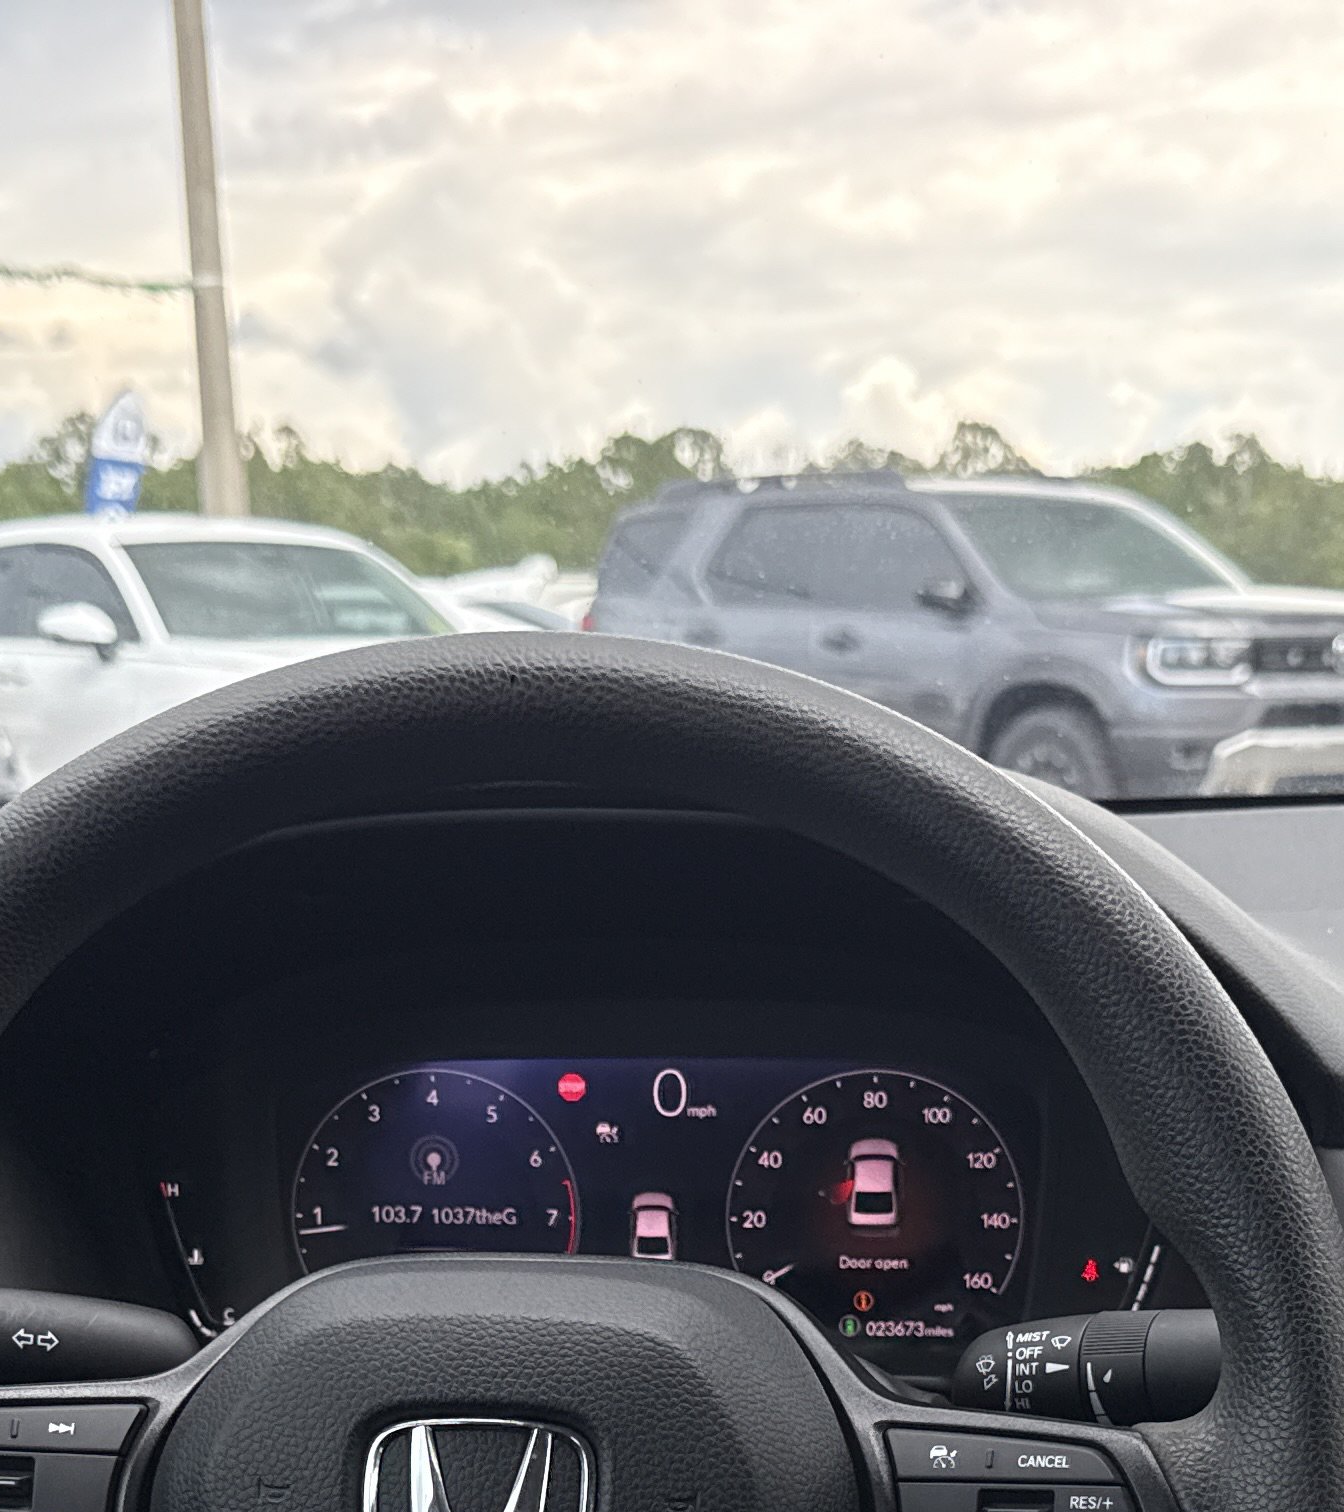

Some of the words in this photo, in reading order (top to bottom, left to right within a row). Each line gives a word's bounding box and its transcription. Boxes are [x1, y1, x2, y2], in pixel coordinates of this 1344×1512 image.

[426, 1089, 439, 1106] 4
[652, 1068, 687, 1117] 0
[687, 1103, 716, 1121] mph
[862, 1092, 888, 1109] 80
[367, 1105, 381, 1122] 3
[486, 1105, 498, 1123] 5
[802, 1107, 827, 1125] 60
[921, 1107, 951, 1124] 100
[326, 1148, 339, 1167] 2
[529, 1150, 542, 1168] 6
[757, 1151, 782, 1169] 40
[966, 1151, 996, 1169] 120
[422, 1171, 446, 1186] FM
[167, 1184, 179, 1197] H
[313, 1207, 323, 1225] 1
[371, 1206, 422, 1224] 103.7
[431, 1207, 517, 1226] 1037theG
[546, 1209, 559, 1227] 7
[742, 1211, 766, 1229] 20
[981, 1213, 1010, 1230] 140
[839, 1254, 872, 1270] Door
[873, 1258, 909, 1271] open
[963, 1273, 993, 1290] 160
[866, 1320, 925, 1337] 023673
[925, 1326, 954, 1337] miles
[1016, 1331, 1050, 1343] MIST
[1015, 1346, 1043, 1360] OFF
[1015, 1362, 1039, 1376] INT
[1015, 1379, 1033, 1394] LO
[1017, 1454, 1071, 1469] CANCEL
[1069, 1495, 1114, 1510] RES/+
